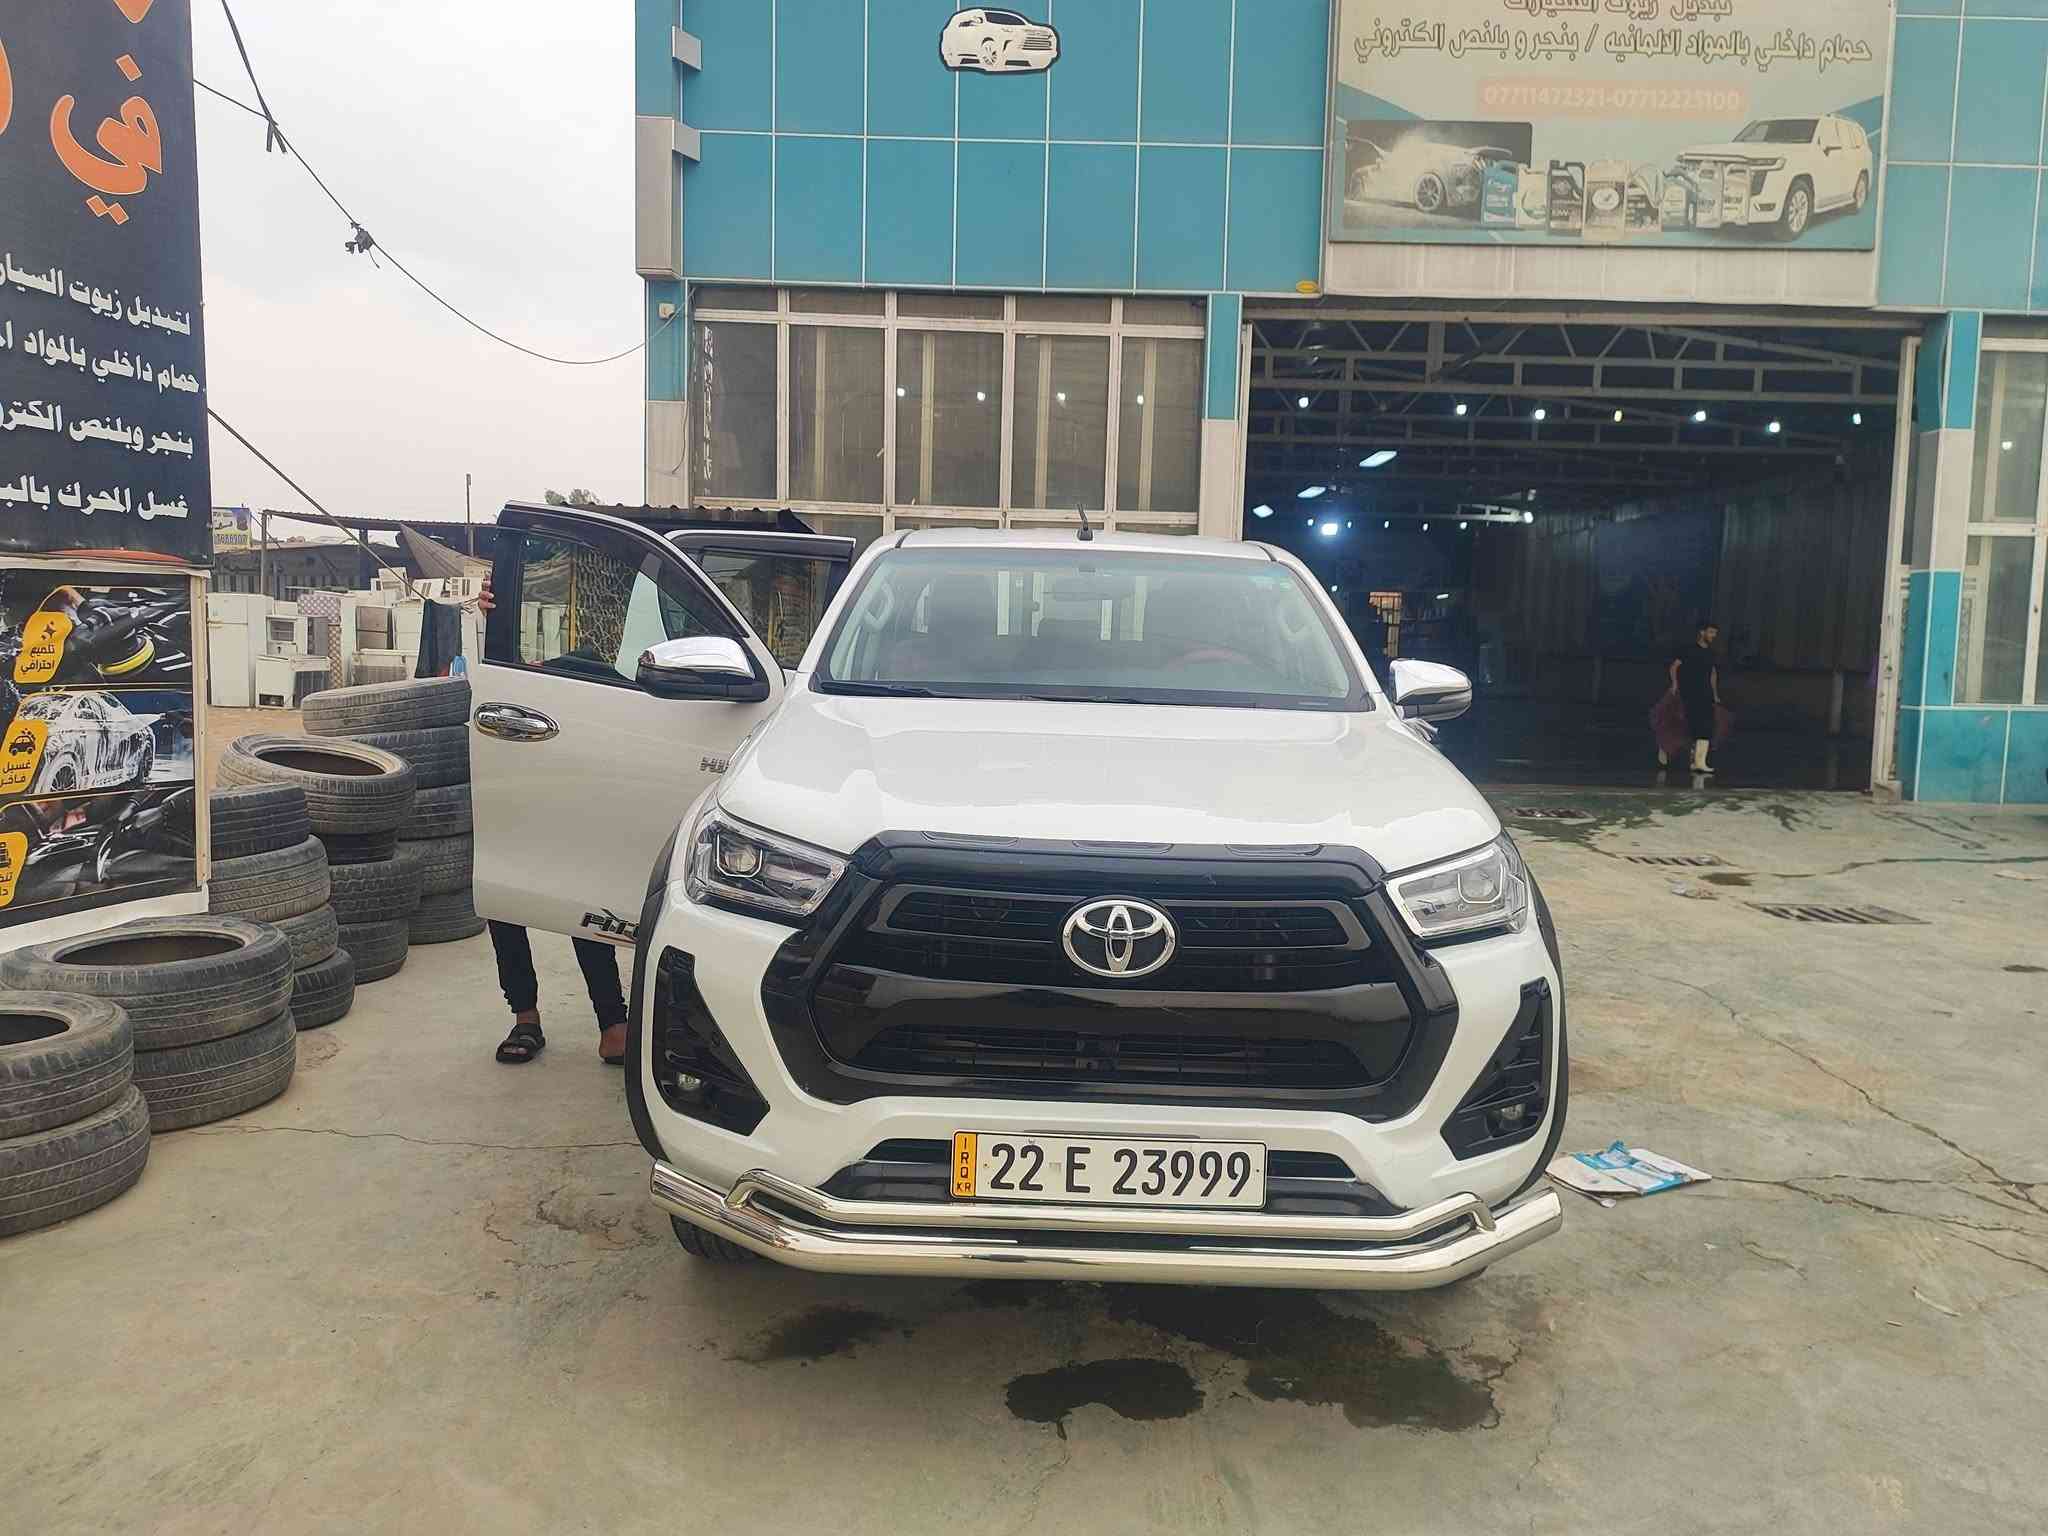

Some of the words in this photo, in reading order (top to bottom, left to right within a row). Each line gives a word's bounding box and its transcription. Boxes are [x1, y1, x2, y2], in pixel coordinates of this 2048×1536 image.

[1353, 17, 1446, 64] الكتروني
[1685, 29, 1751, 66] بالمواد
[1754, 28, 1816, 73] داخلي
[1818, 34, 1873, 74] حمام
[68, 279, 123, 321] زيوت
[126, 295, 192, 336] لتبديل
[23, 328, 87, 373] بالمواد
[91, 348, 154, 384] داخلي
[156, 363, 200, 394] حمام
[146, 430, 194, 460] بنجر
[57, 480, 131, 516] المحرك
[136, 490, 191, 521] غسل
[20, 659, 56, 676] احترافي
[2, 758, 32, 774] غسيل
[990, 1142, 1045, 1192] 22
[1065, 1145, 1092, 1194] E
[1112, 1148, 1251, 1198] 23999
